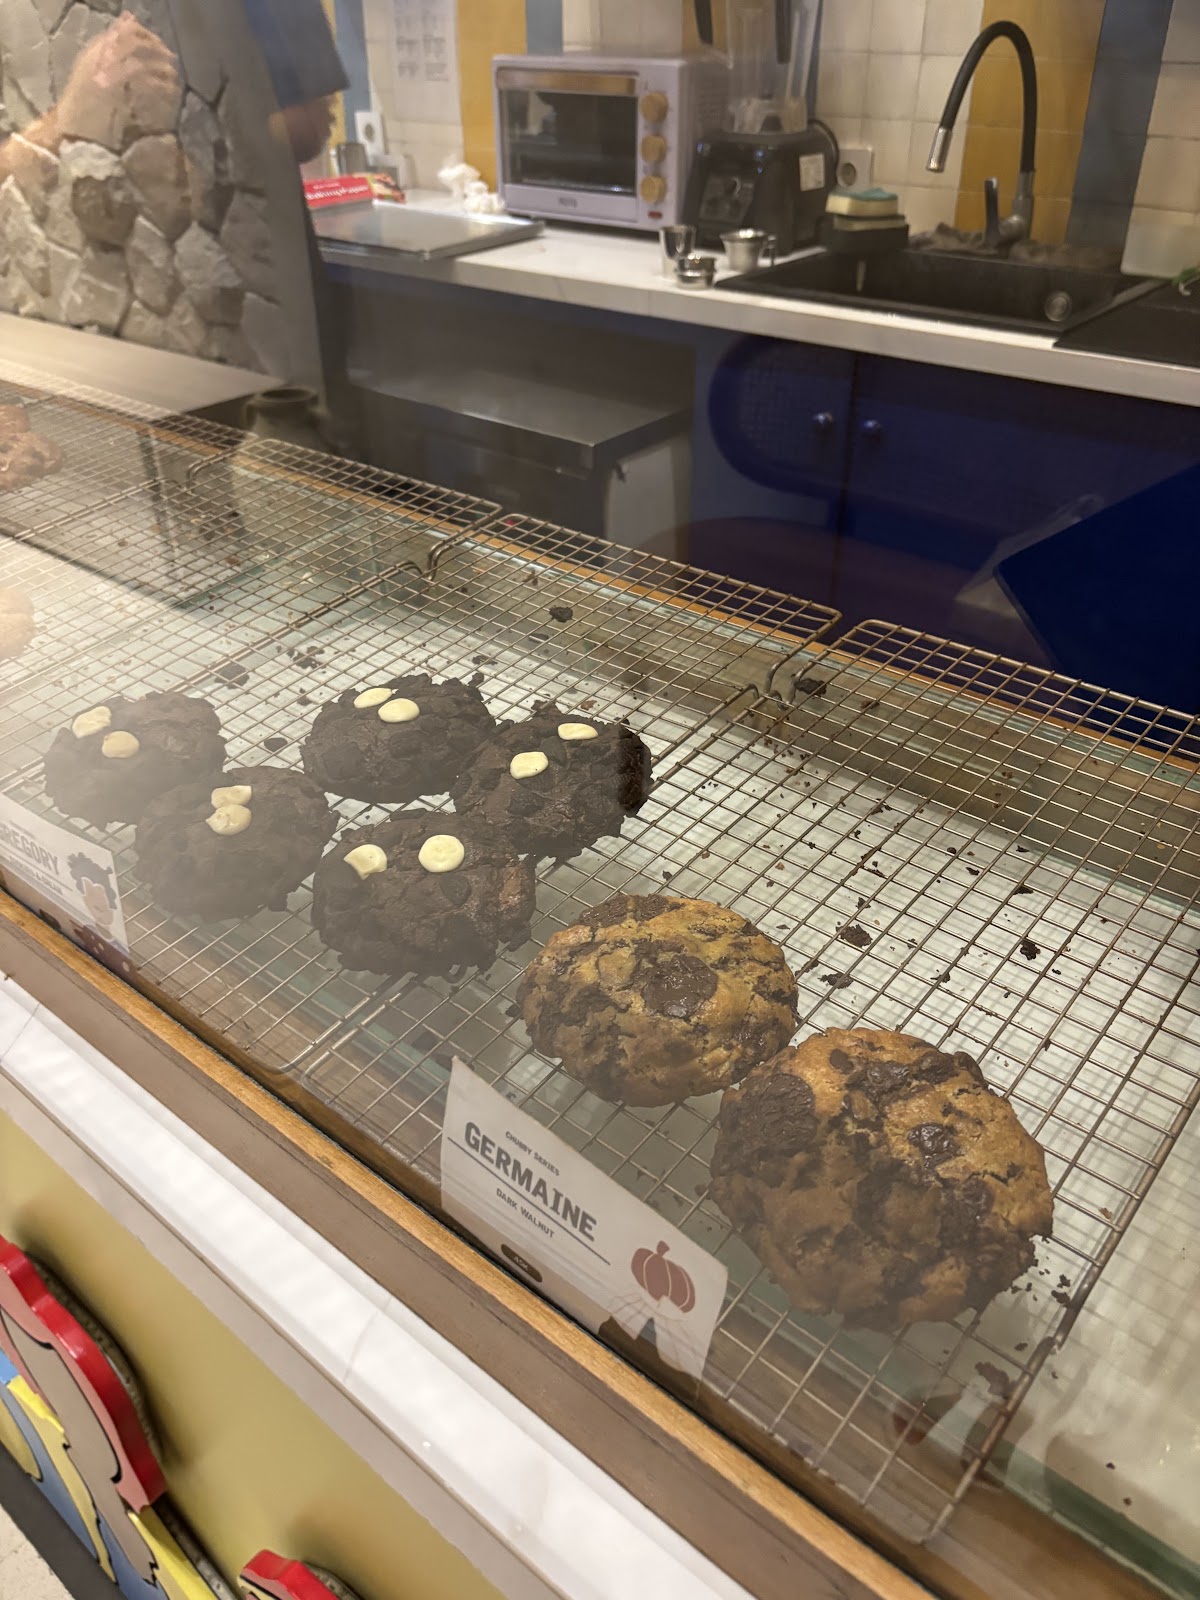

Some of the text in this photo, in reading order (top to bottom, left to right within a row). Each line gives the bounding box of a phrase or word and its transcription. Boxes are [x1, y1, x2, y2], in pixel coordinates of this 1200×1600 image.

[505, 1131, 560, 1176] CHUBBY SERIES
[464, 1121, 597, 1242] GERMAINE
[496, 1187, 554, 1238] DARK WALNUT
